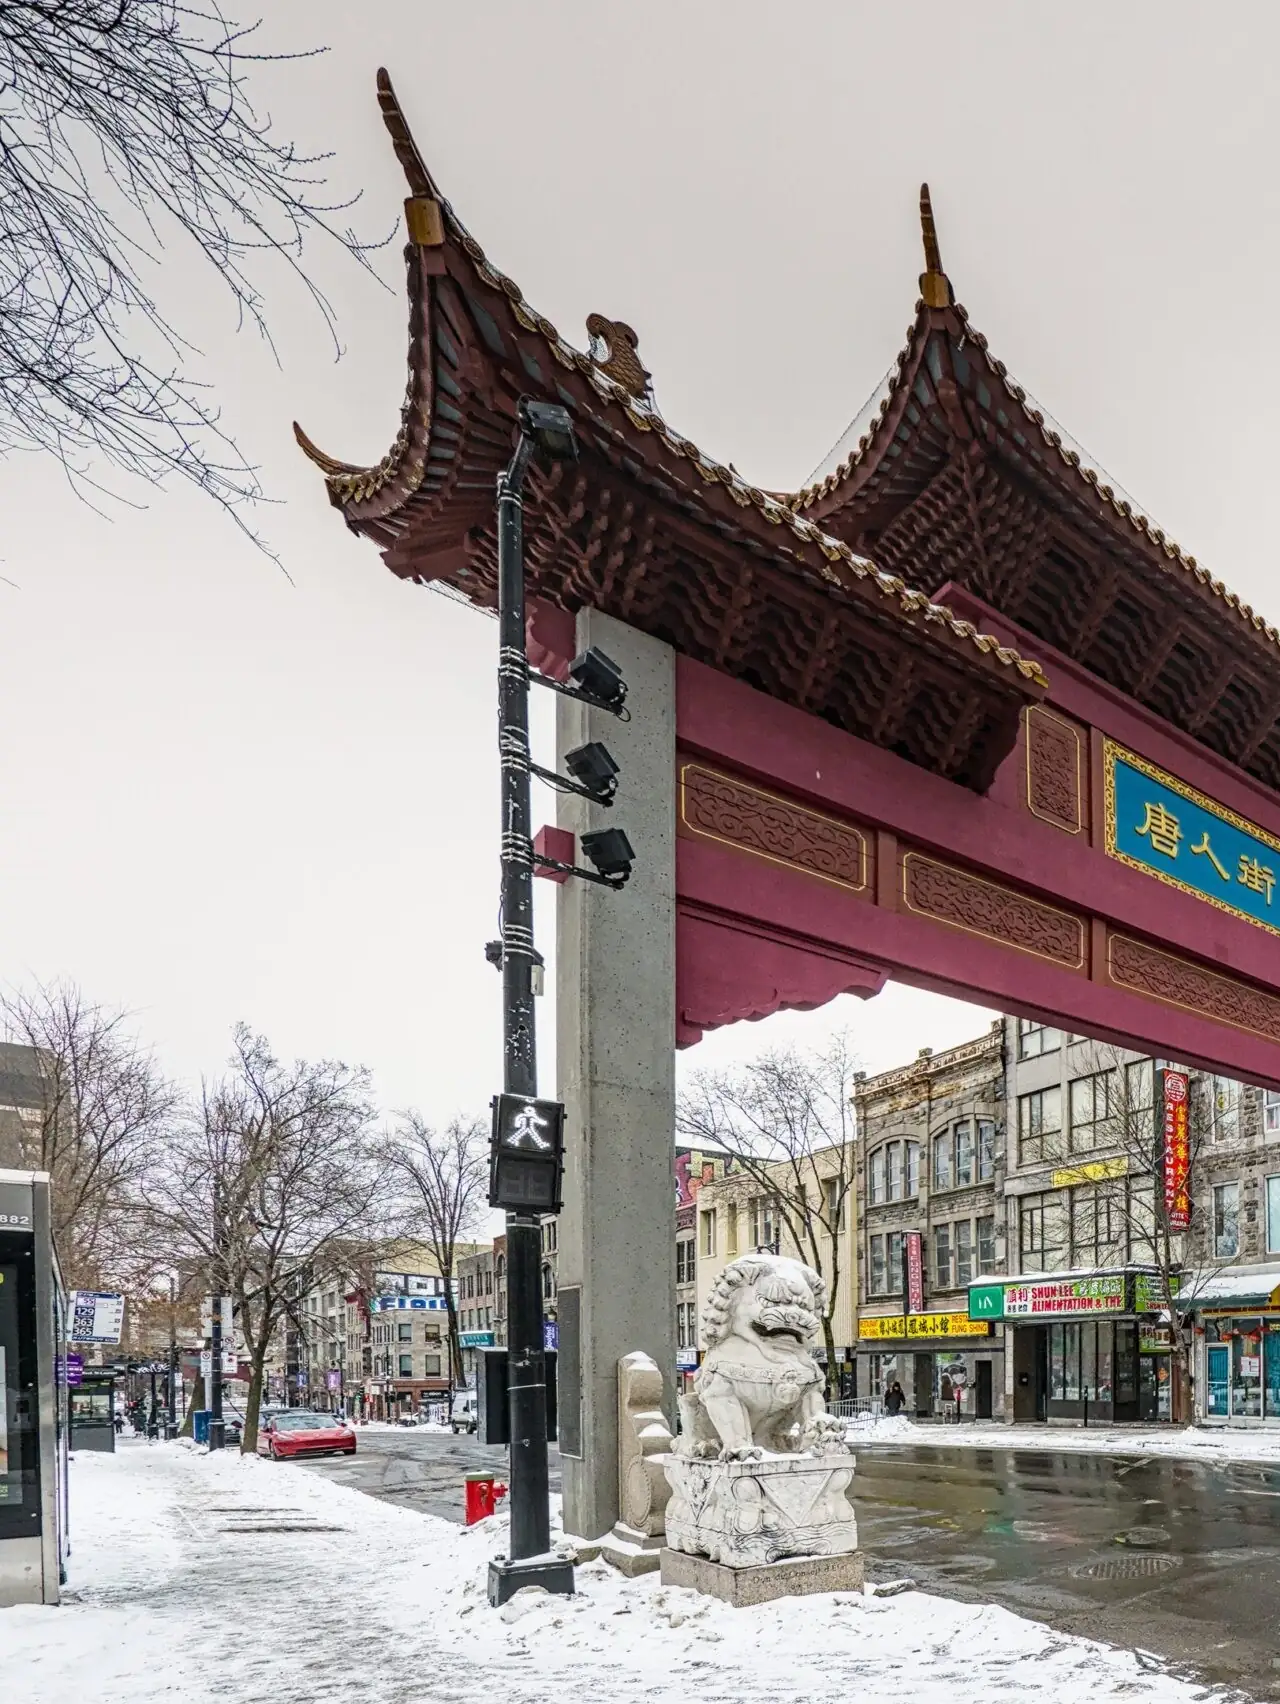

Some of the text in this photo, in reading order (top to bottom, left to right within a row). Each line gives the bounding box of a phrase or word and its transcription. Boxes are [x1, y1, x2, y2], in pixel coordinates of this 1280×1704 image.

[1134, 801, 1276, 906] 唐人街
[1165, 1102, 1175, 1208] RESTAURANT
[1031, 1284, 1074, 1299] SHUN LEE
[77, 1307, 95, 1316] 129
[1031, 1297, 1093, 1313] ALIMENTATION
[1095, 1299, 1103, 1308] &
[75, 1317, 93, 1327] 363
[951, 1322, 987, 1333] FUNG SHING
[74, 1327, 92, 1336] 365
